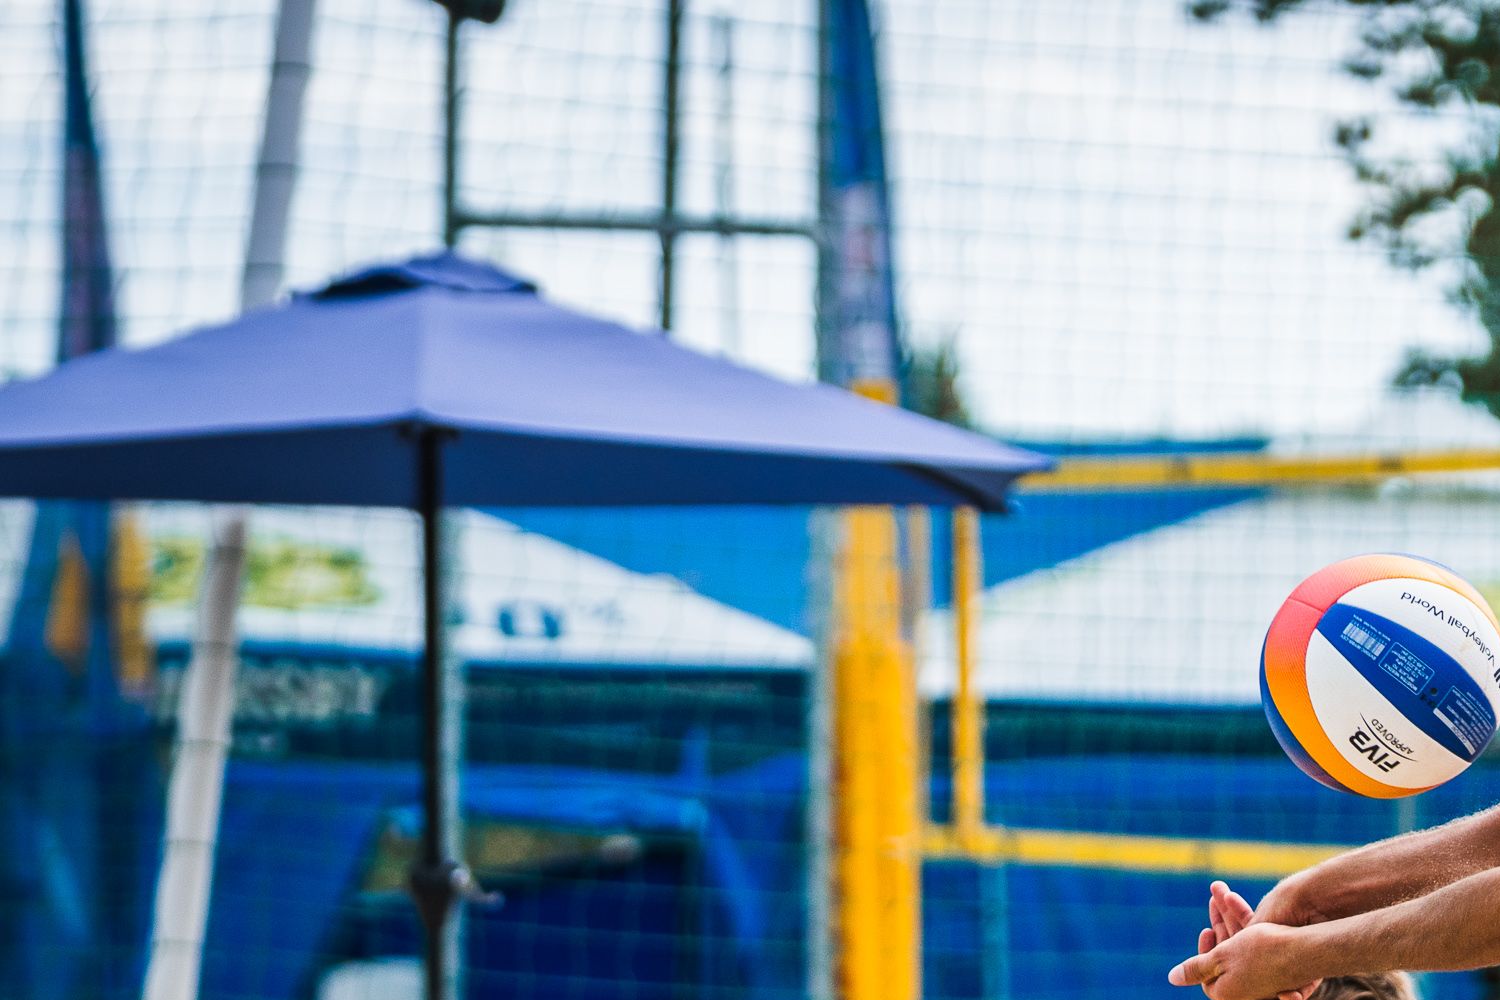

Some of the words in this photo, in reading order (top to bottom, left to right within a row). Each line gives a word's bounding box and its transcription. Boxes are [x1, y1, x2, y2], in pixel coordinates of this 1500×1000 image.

[1401, 592, 1444, 620] World
[1447, 615, 1495, 667] Volleyball
[1371, 718, 1414, 755] APPROVED
